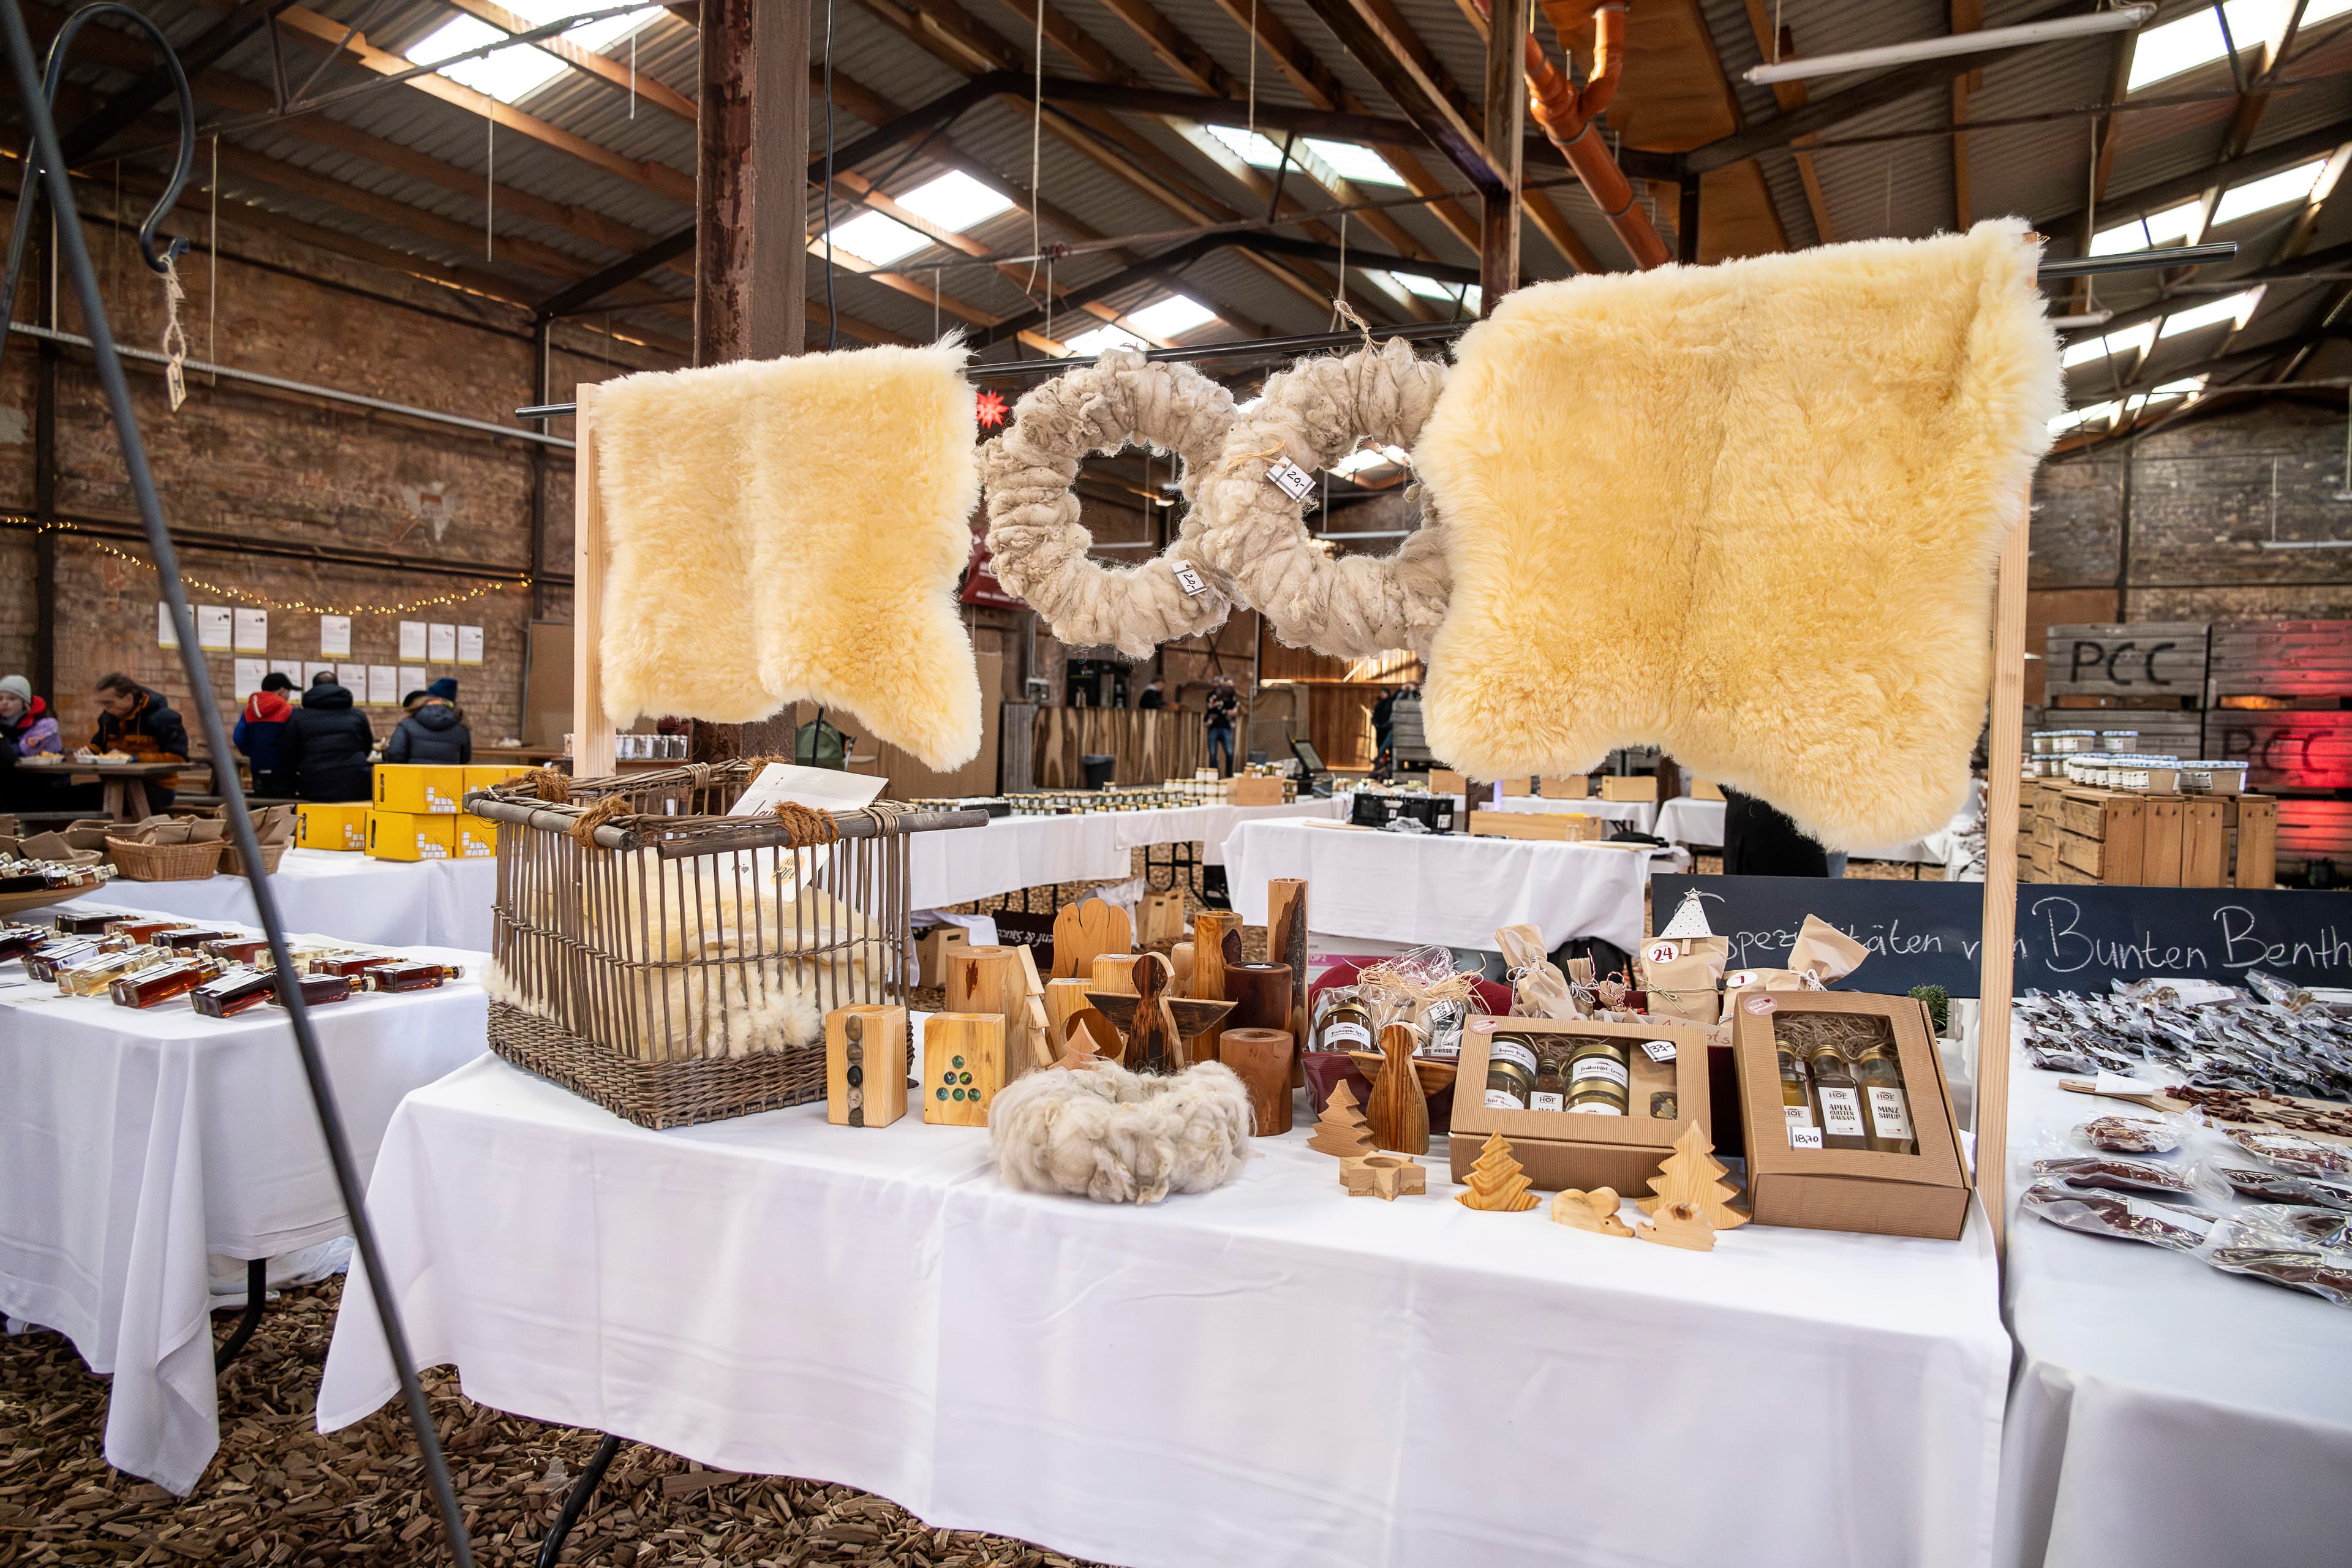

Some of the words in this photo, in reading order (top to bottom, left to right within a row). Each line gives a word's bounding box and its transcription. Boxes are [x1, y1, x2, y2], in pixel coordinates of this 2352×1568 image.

[2070, 641, 2176, 685] PCC
[2222, 729, 2334, 773] PCC
[1654, 947, 1673, 961] 24
[2031, 896, 2208, 973] Bunten
[1795, 1134, 1819, 1144] 18,70
